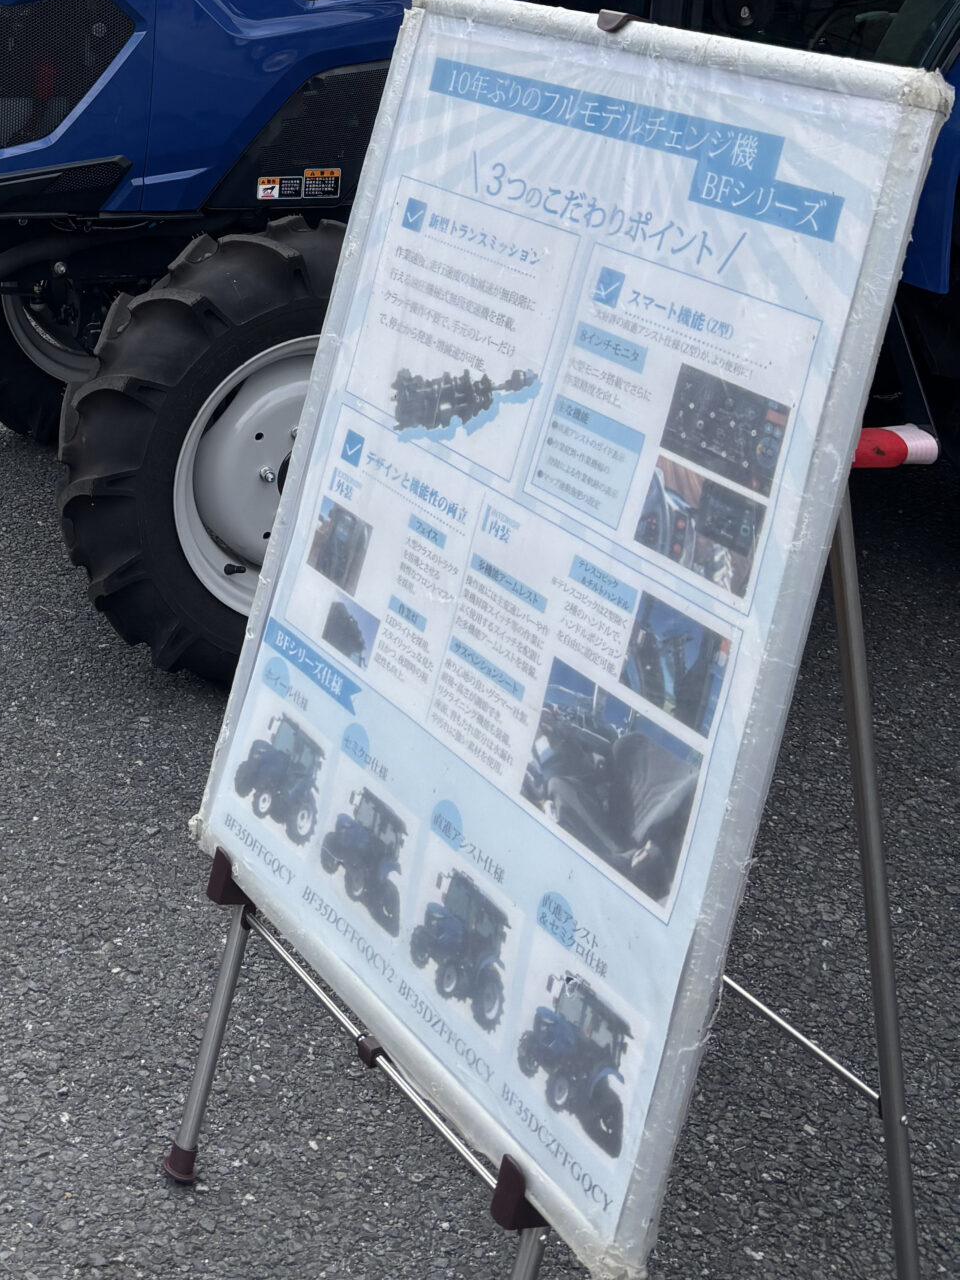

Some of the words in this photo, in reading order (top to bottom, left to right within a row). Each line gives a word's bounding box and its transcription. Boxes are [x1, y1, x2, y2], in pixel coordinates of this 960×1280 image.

[446, 68, 761, 172] 10年ぶりのフルモデルチェンジ機
[483, 160, 717, 269] 3つのこだわりポイント
[700, 171, 829, 233] BFシリーズ
[427, 212, 542, 268] 新型トランスミッション
[578, 327, 641, 364] 8インチモニタ
[334, 478, 354, 502] 外装
[364, 448, 469, 526] デザインと機能性の両立
[487, 516, 513, 546] 内装
[274, 628, 344, 698] BFシリーズ仕様
[432, 810, 506, 885] 直進アシスト仕様
[540, 891, 600, 953] 直進アシスト
